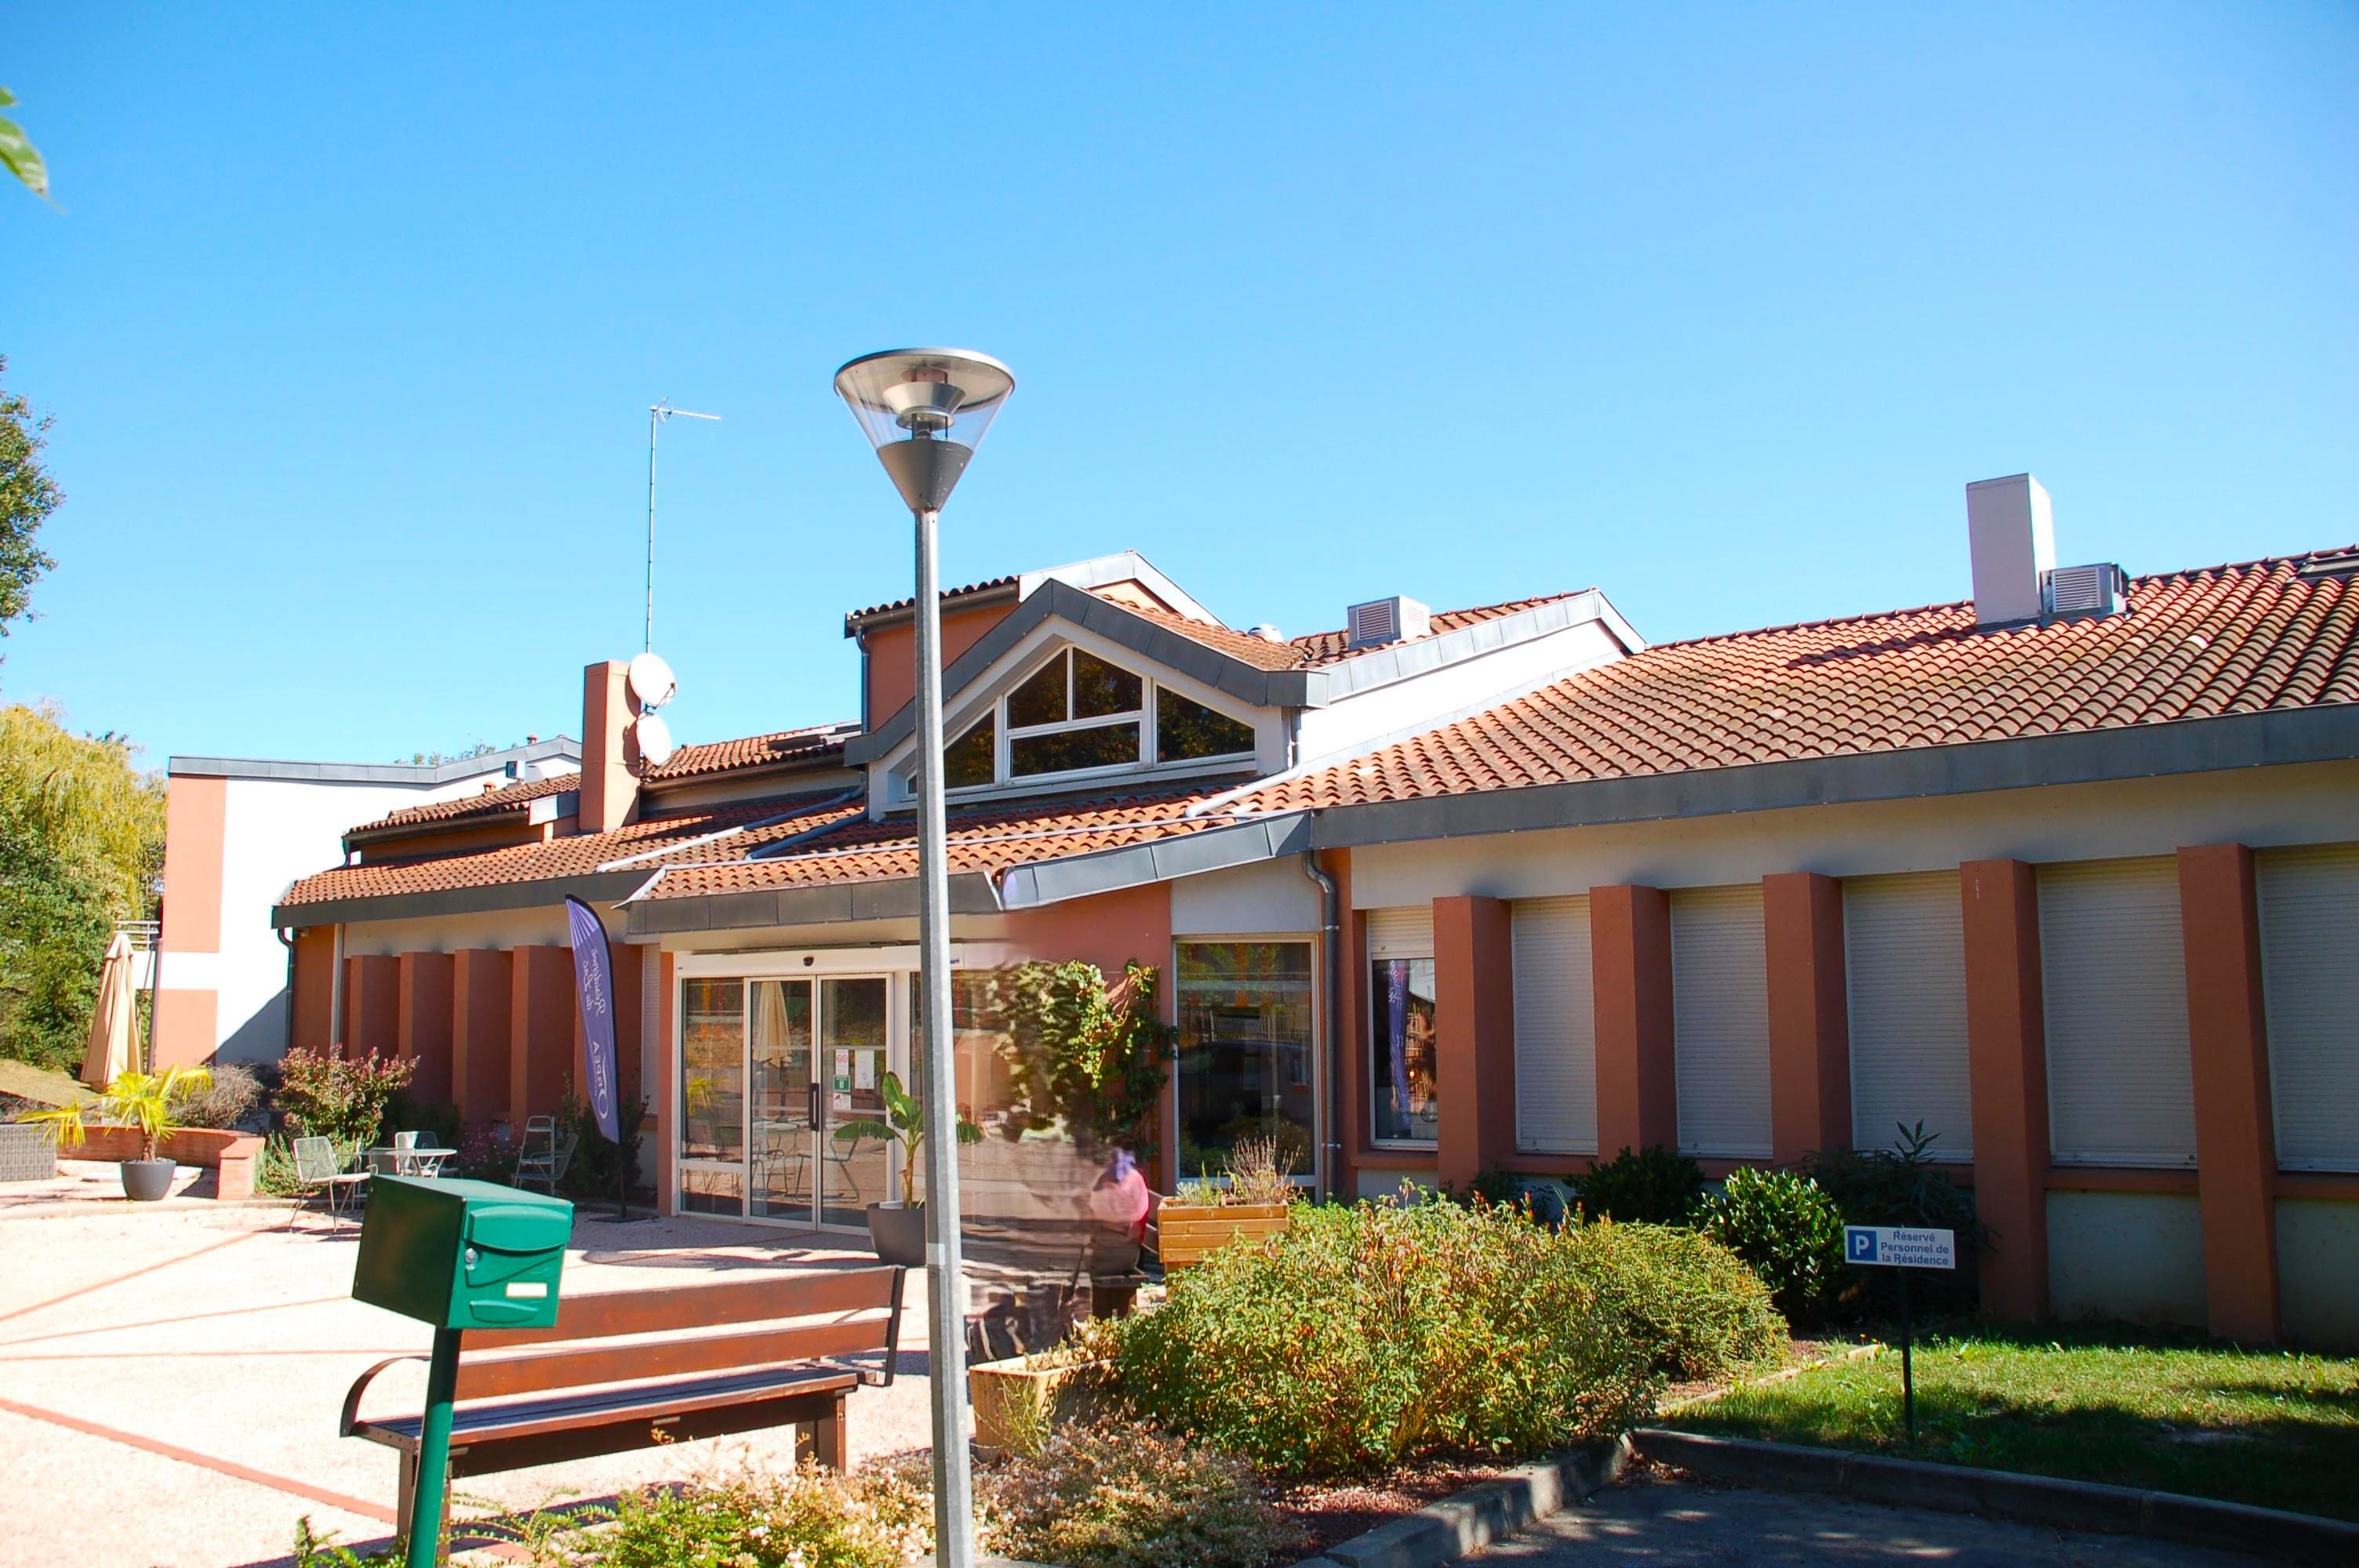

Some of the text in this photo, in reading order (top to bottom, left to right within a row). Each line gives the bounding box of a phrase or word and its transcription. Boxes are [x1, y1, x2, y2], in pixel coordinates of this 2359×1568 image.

[1893, 1230, 1936, 1242] Réservé
[1856, 1235, 1870, 1255] P
[1881, 1242, 1949, 1254] Personnel de
[1882, 1254, 1948, 1265] la Résidence
